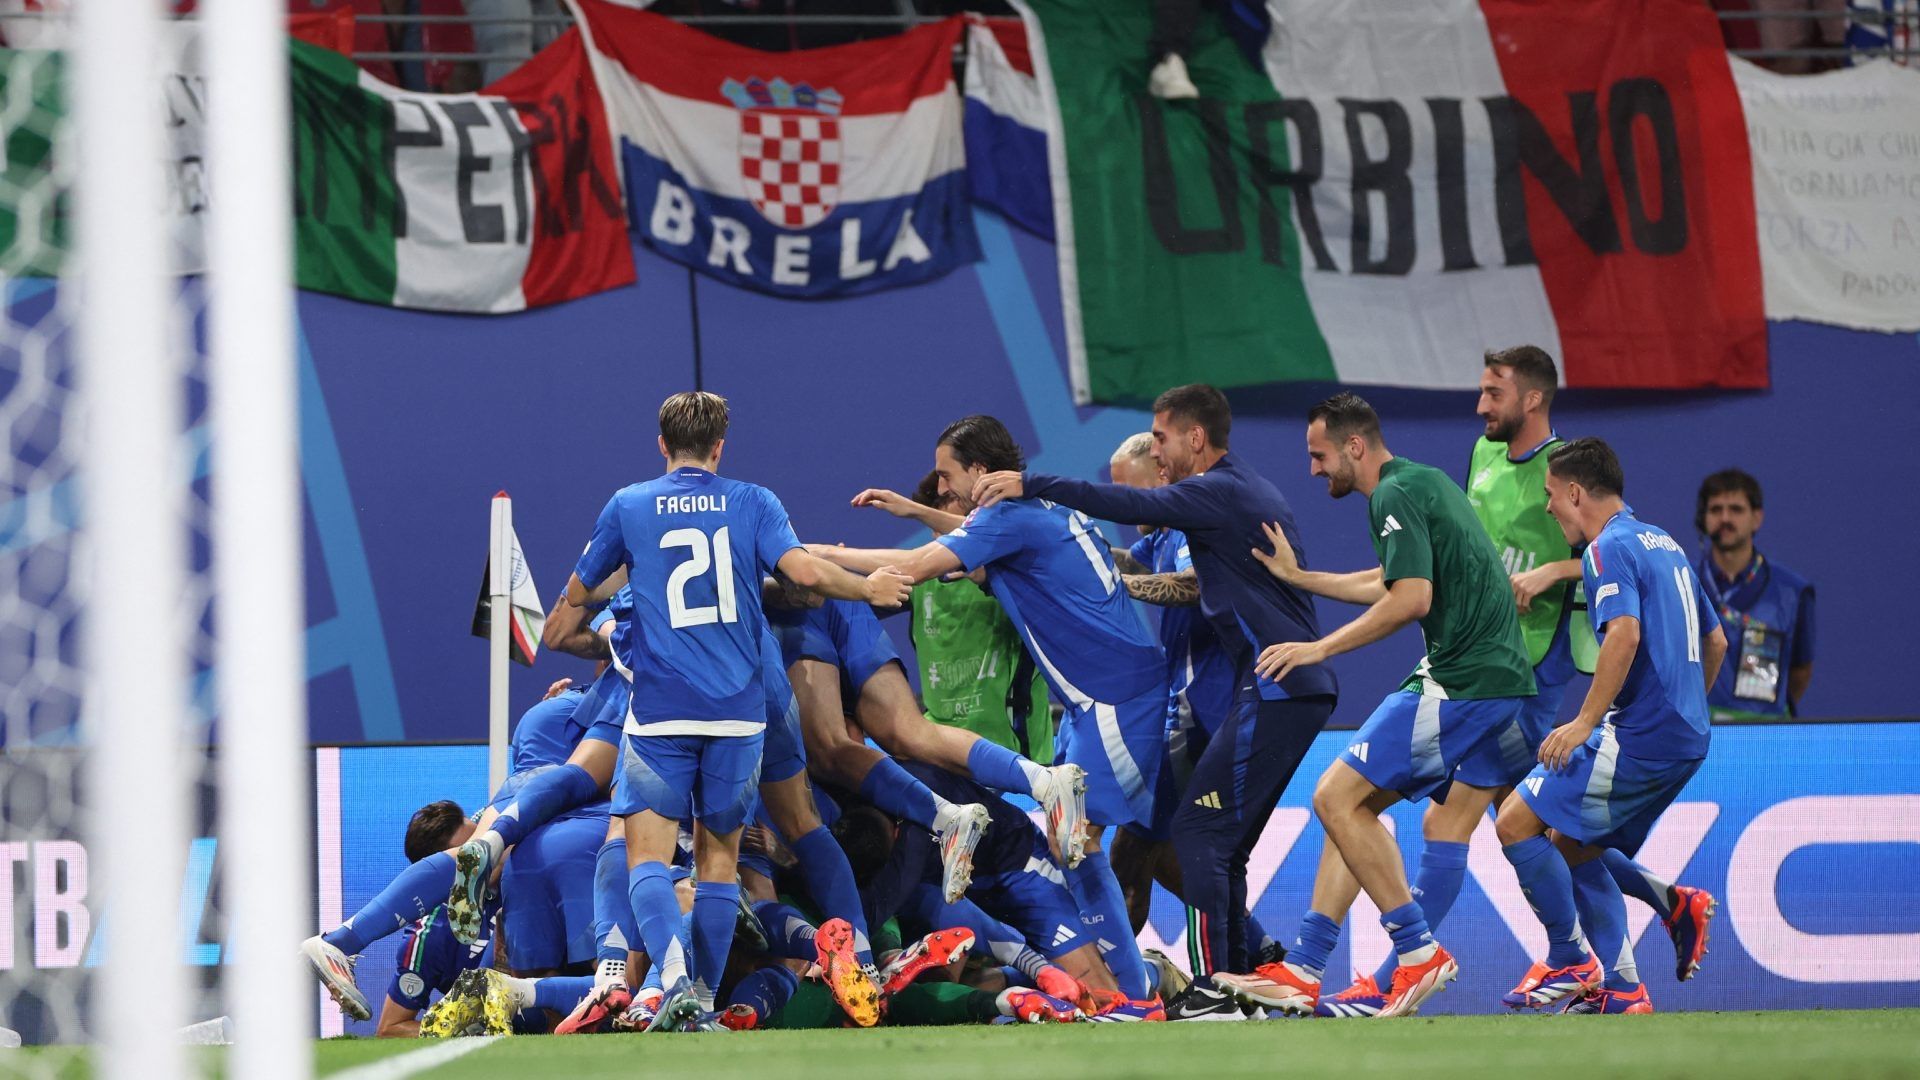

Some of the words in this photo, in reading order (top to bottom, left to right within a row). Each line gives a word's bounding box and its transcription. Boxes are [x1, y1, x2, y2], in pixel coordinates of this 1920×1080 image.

[1134, 77, 1690, 277] URBINO
[650, 179, 932, 287] BRELA
[656, 495, 727, 515] FAGIOLI
[659, 525, 738, 629] 21
[1673, 566, 1701, 663] 11
